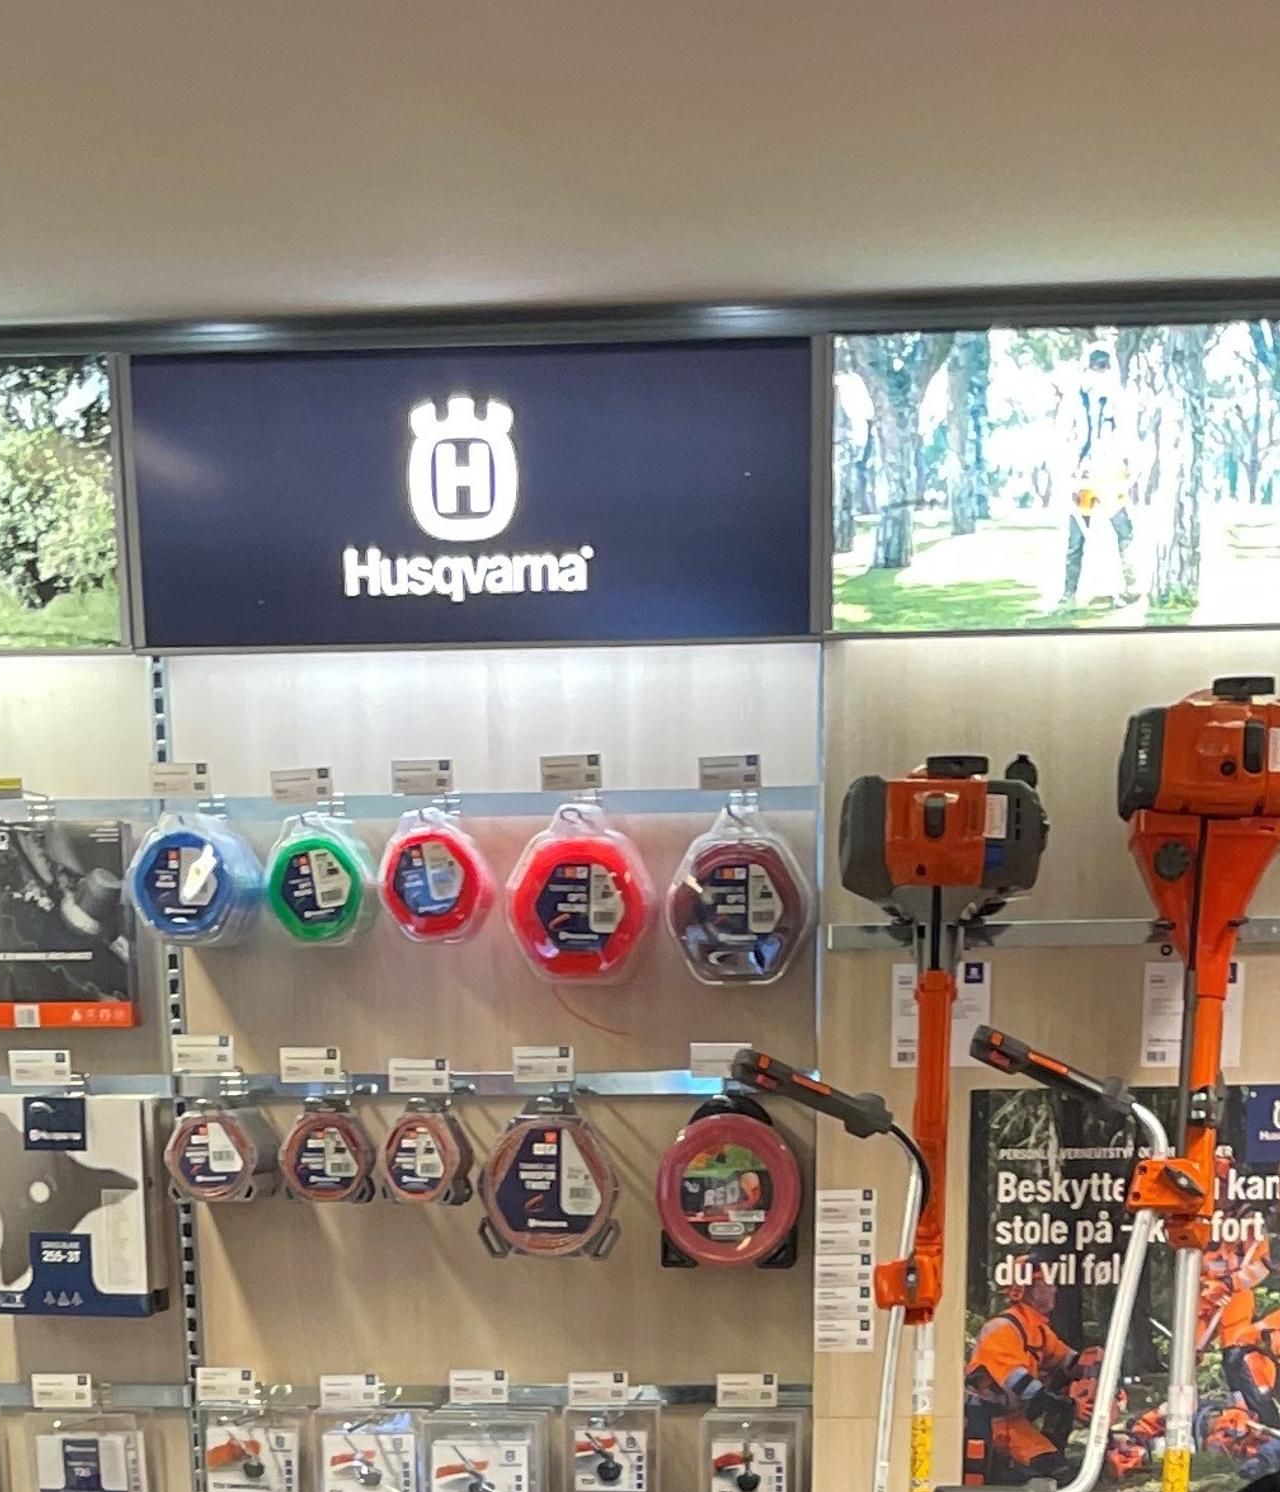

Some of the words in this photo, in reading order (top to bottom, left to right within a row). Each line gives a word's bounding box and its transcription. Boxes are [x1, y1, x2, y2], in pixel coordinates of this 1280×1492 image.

[342, 546, 590, 603] Husqvarna
[997, 1171, 1126, 1211] Beskytte
[995, 1213, 1068, 1245] stole
[1075, 1211, 1113, 1250] på
[1148, 1210, 1265, 1244] kfort
[995, 1255, 1032, 1286] du
[1039, 1253, 1076, 1286] vil
